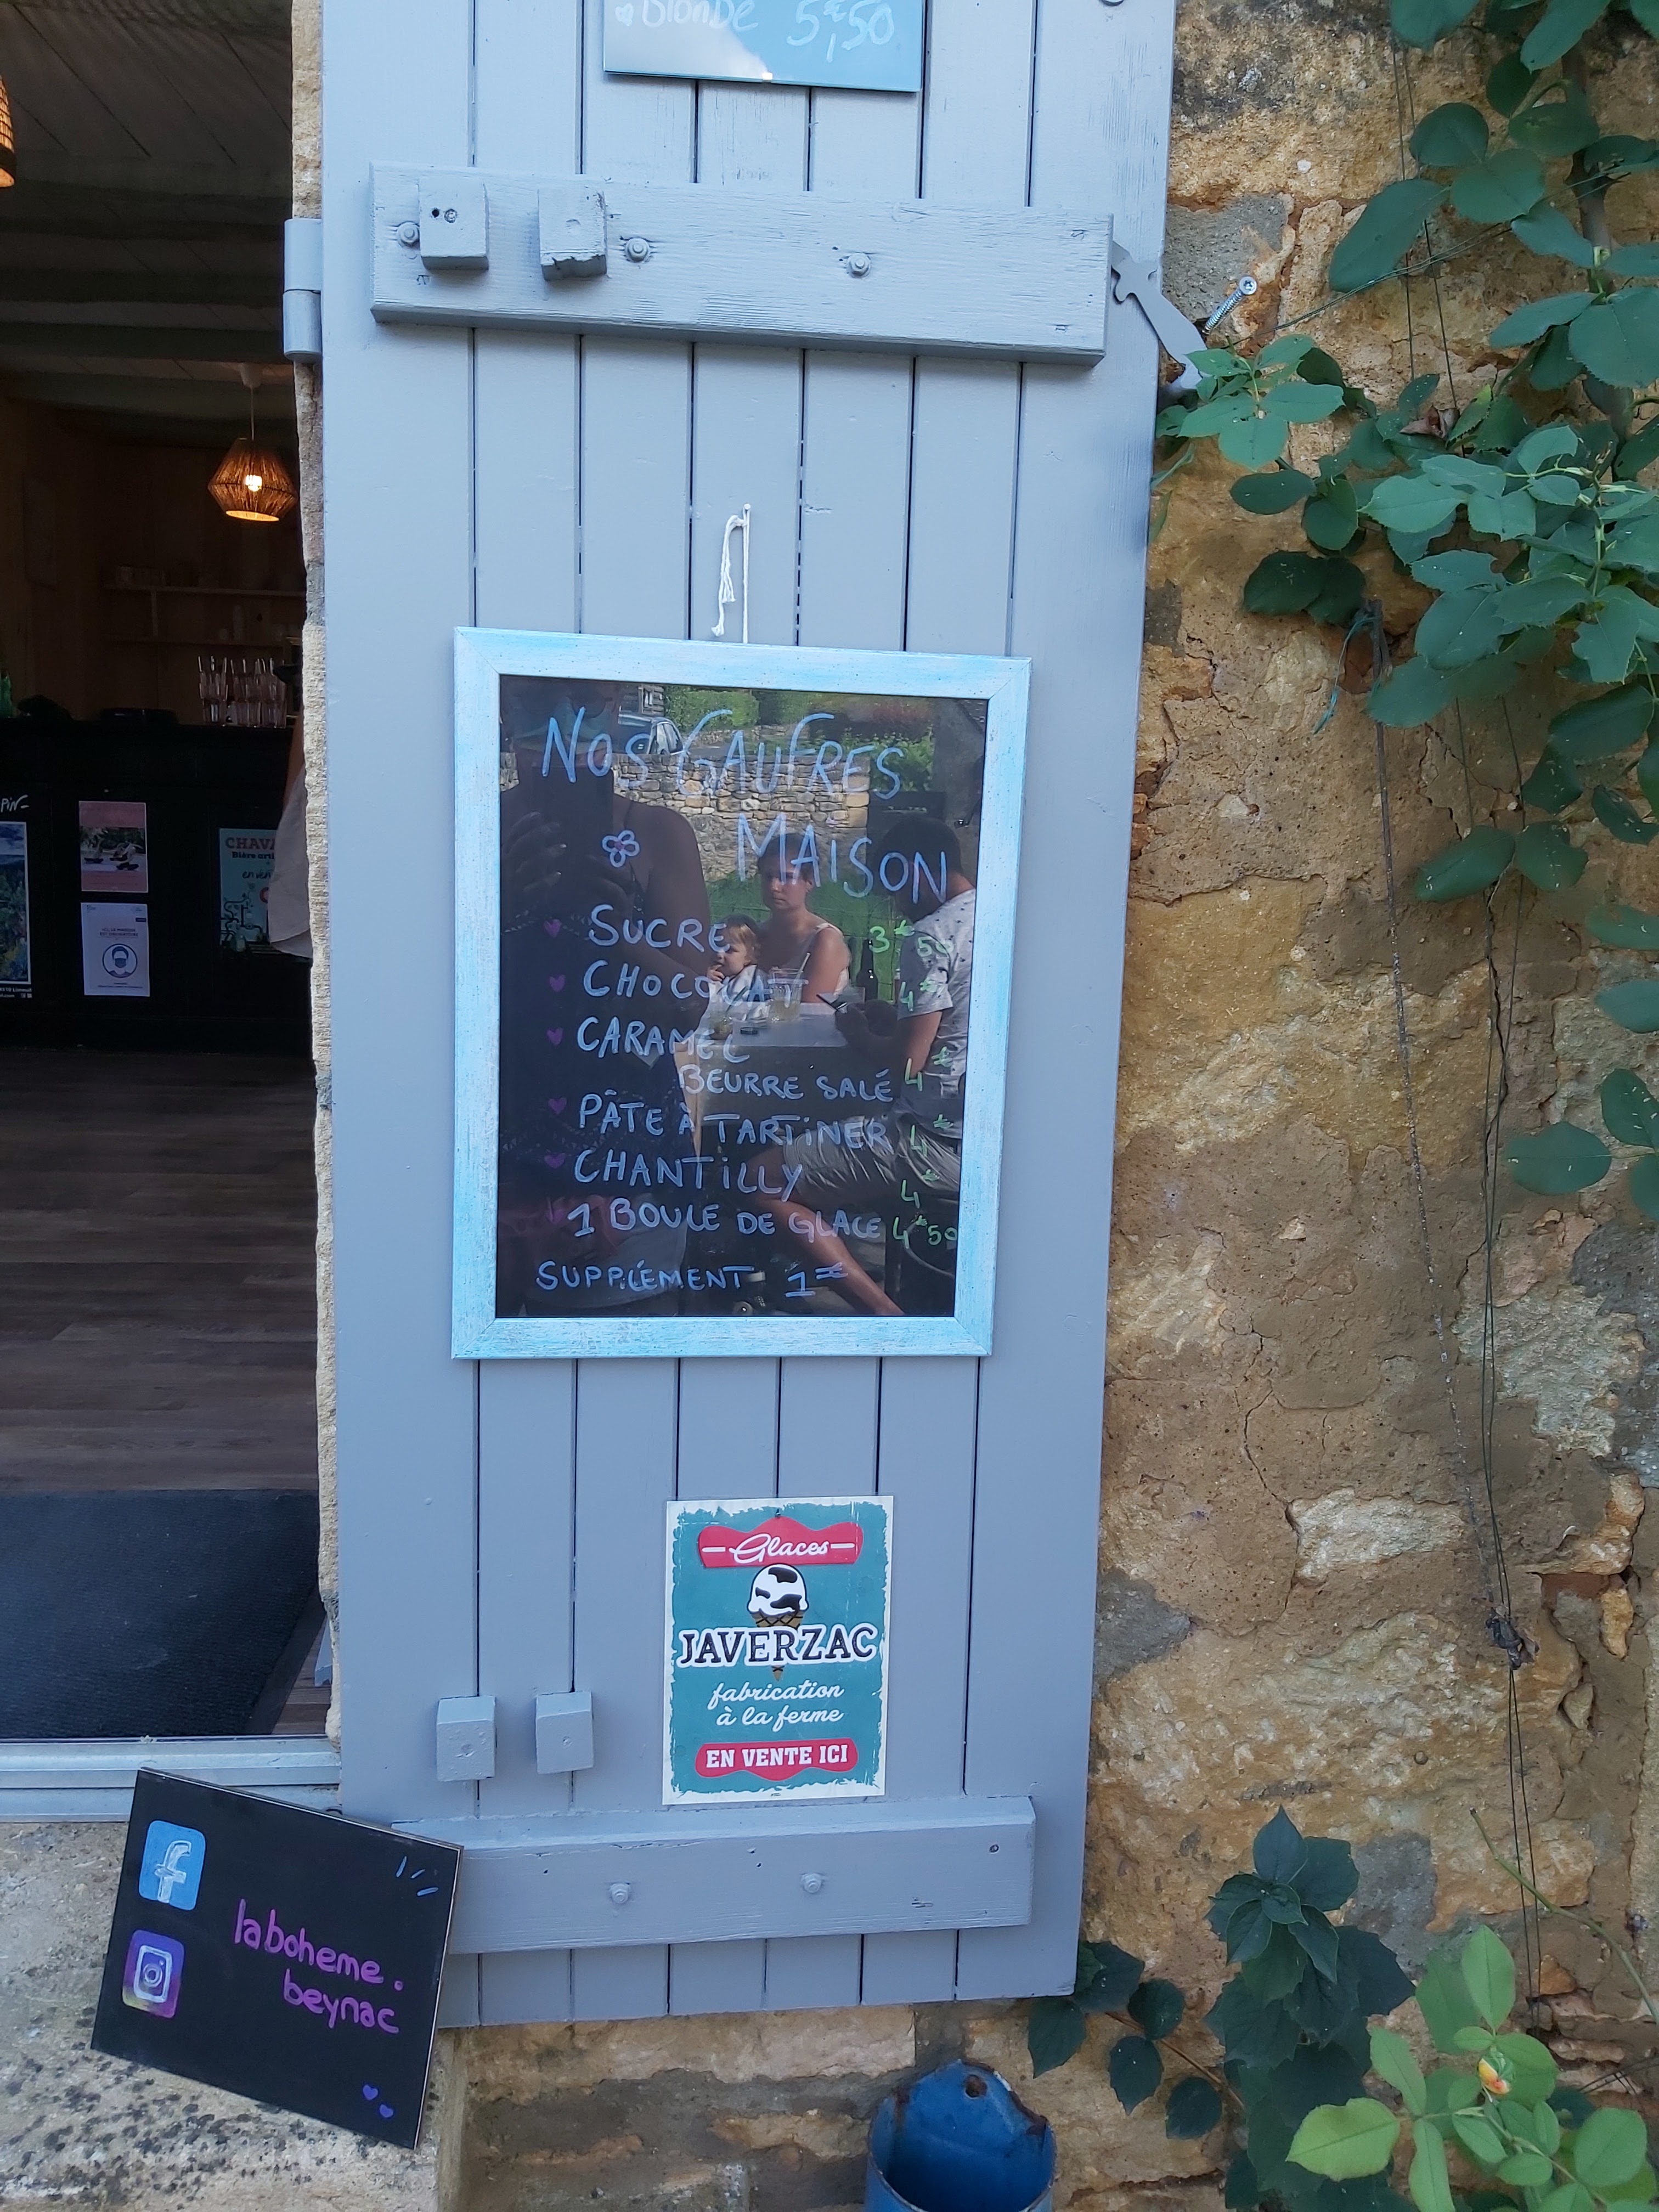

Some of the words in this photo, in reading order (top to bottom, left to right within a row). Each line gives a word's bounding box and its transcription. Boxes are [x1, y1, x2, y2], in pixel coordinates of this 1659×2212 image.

[676, 709, 904, 801] GAUFRES
[737, 812, 947, 904] MAISON
[589, 904, 730, 953] SUCRE
[583, 959, 809, 1008] CHOCOLAT
[577, 1016, 750, 1063] CARAMEL
[679, 1065, 804, 1099] BEURRE
[817, 1069, 894, 1102] SALÉ
[579, 1088, 663, 1136] PÂTE
[567, 1203, 595, 1237] 1
[610, 1198, 721, 1232] BOULE
[737, 1212, 775, 1235] DE
[788, 1210, 882, 1243] GLACE
[729, 1533, 830, 1564] Glaces
[679, 1625, 877, 1666] JAVERZAC
[707, 1679, 844, 1710] fabrication
[716, 1706, 736, 1726] à
[741, 1706, 773, 1725] la
[772, 1705, 844, 1732] ferme
[706, 1748, 735, 1768] EN
[742, 1746, 812, 1767] VENTE
[819, 1744, 848, 1763] ICI
[283, 1968, 399, 2033] beynac
